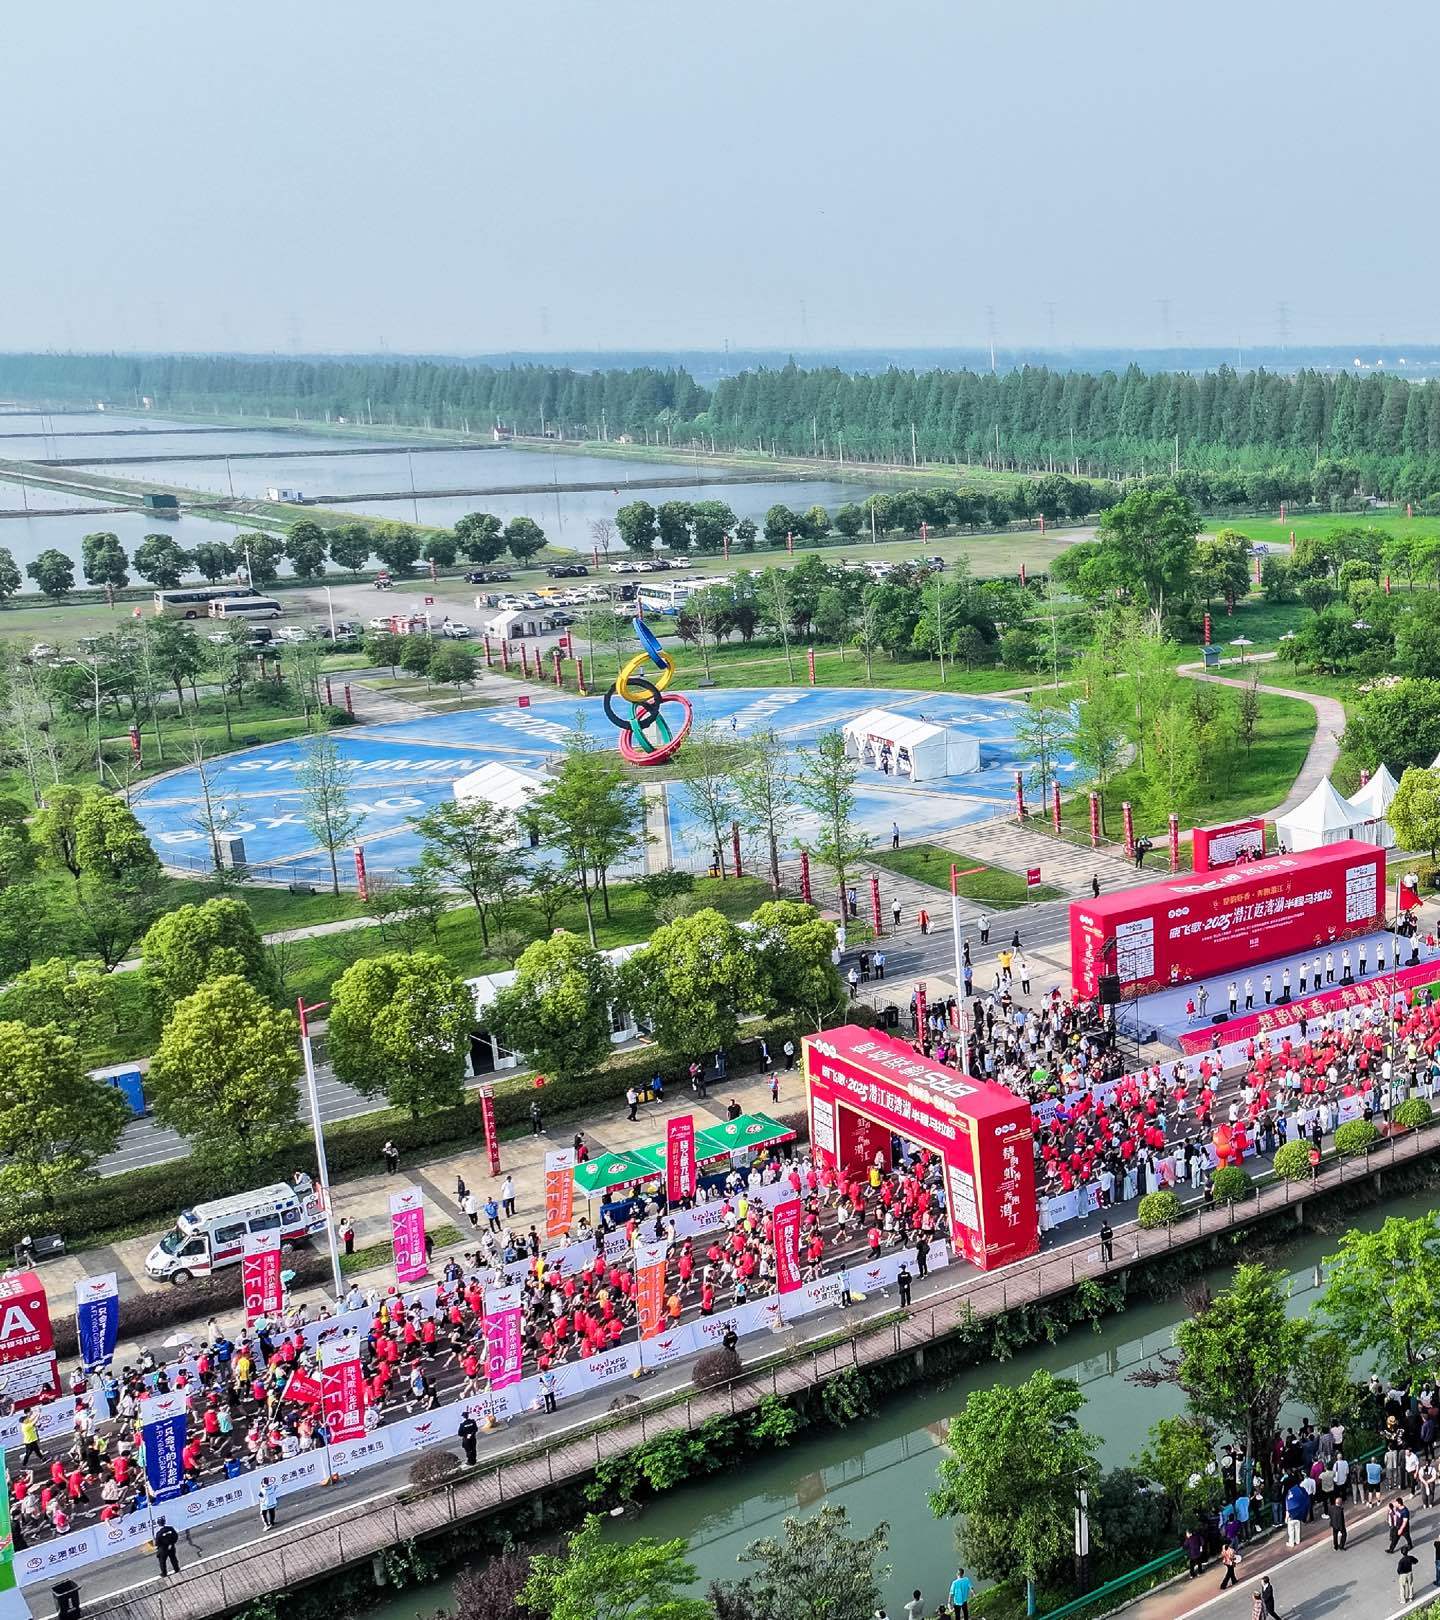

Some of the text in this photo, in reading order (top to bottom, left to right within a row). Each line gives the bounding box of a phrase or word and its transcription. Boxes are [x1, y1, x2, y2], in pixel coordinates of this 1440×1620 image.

[392, 1217, 409, 1264] XFG
[245, 1259, 262, 1308] XFG
[0, 1305, 36, 1340] A
[486, 1318, 505, 1371] XFG
[321, 1370, 344, 1425] XFG
